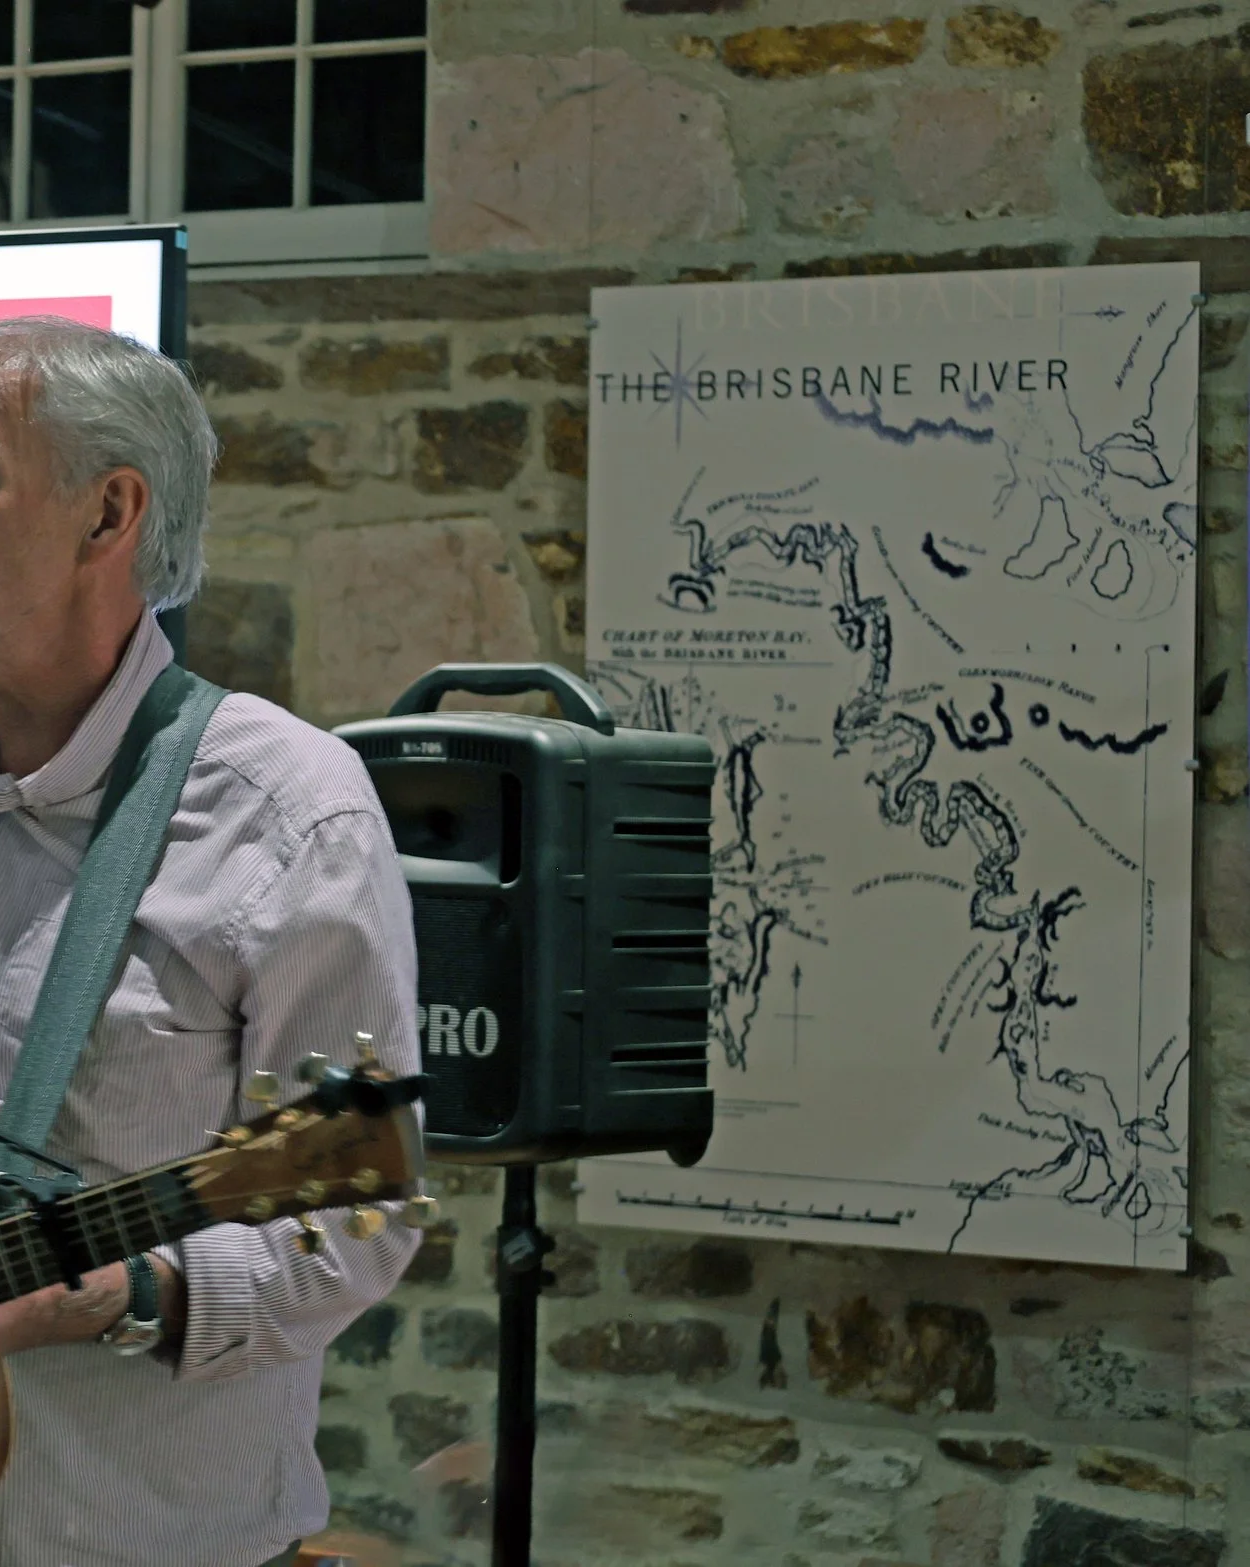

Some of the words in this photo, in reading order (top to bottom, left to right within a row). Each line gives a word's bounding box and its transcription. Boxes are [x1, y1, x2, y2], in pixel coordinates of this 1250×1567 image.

[596, 370, 674, 403] THE
[697, 364, 913, 402] BRISBANE
[940, 358, 1069, 394] RIVER
[602, 628, 658, 643] CHART
[662, 629, 684, 643] OF
[688, 628, 771, 644] MORETON
